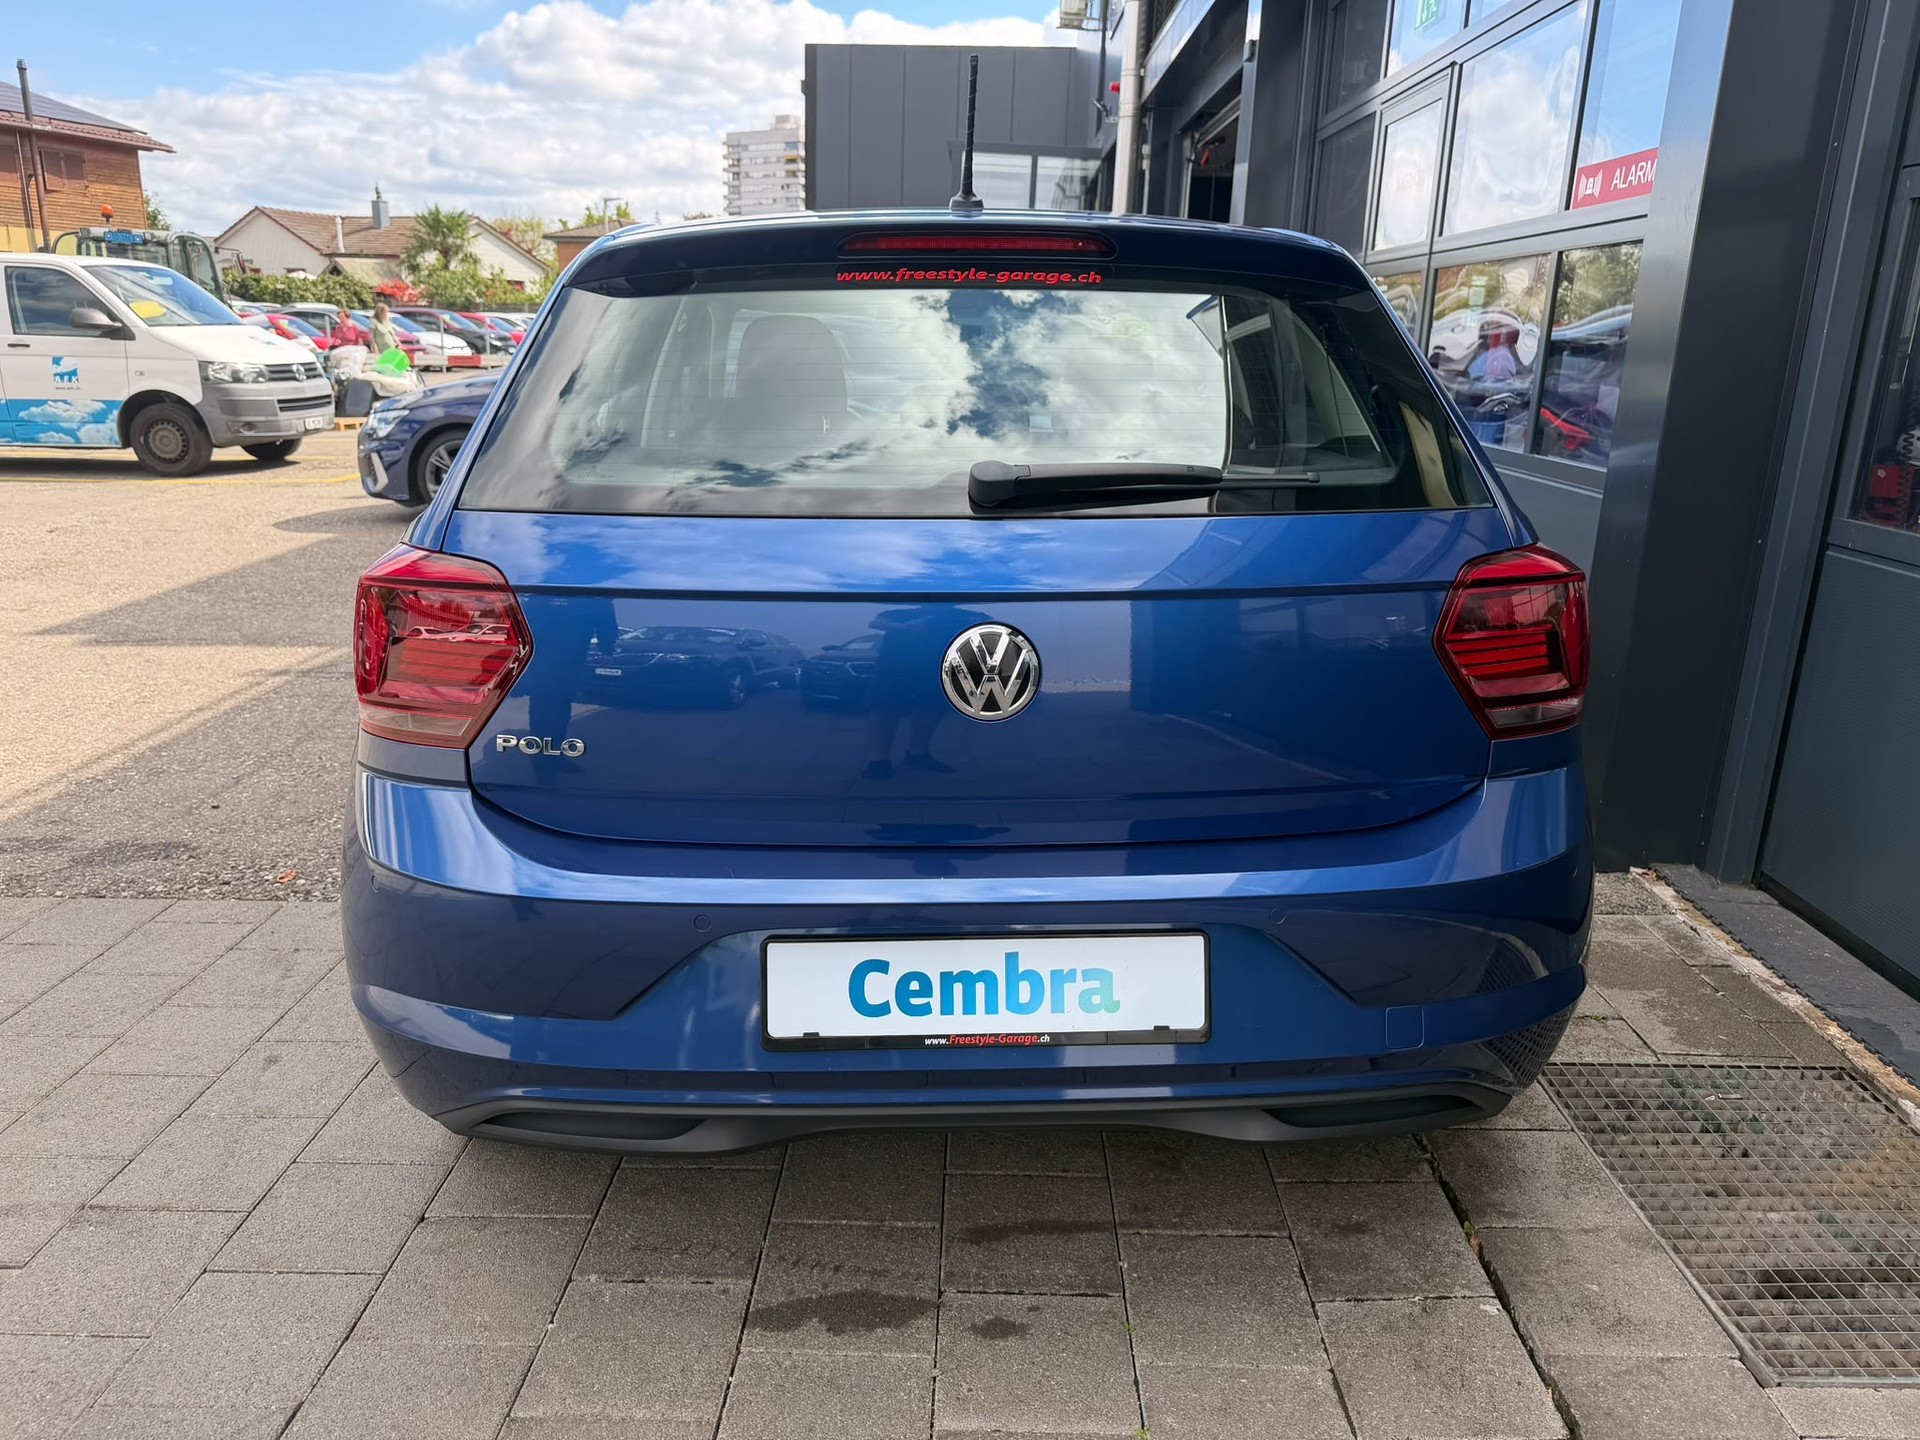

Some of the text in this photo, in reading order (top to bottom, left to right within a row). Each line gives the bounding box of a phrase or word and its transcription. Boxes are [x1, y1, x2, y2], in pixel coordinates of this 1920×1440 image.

[1610, 158, 1658, 191] ALARM
[837, 267, 1102, 284] www.freestyle-garage.ch
[496, 734, 585, 757] POLO
[848, 951, 1121, 1018] Cembra
[924, 1033, 1050, 1047] www.Freestyle-Garage.ch
